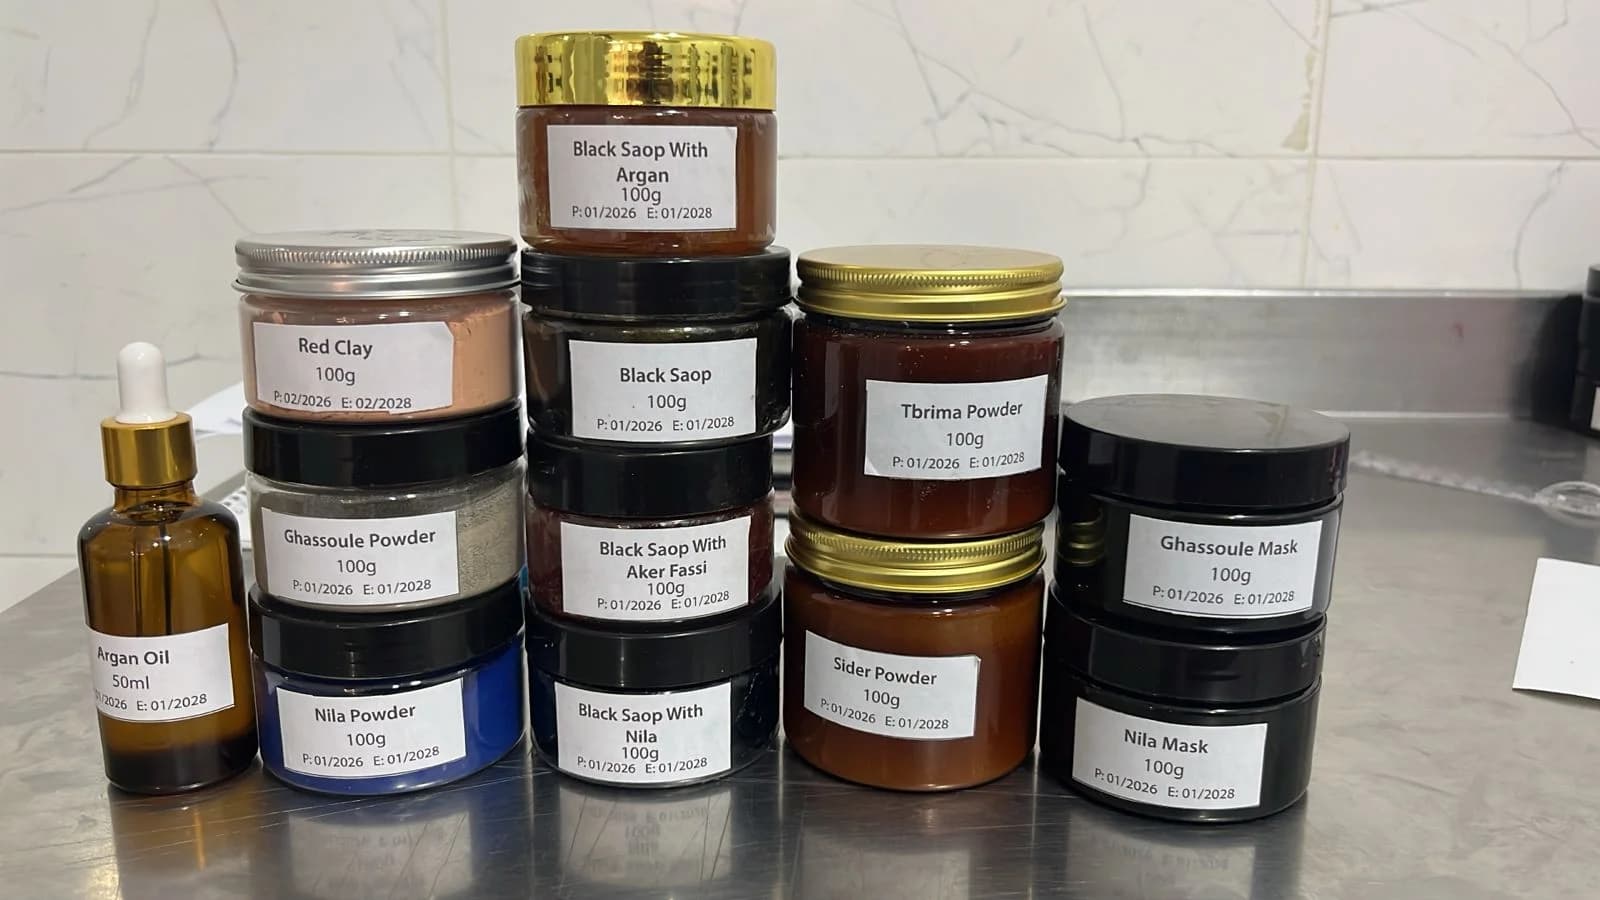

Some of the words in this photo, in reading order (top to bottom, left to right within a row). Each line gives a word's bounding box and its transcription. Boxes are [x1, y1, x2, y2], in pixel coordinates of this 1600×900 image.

[573, 139, 616, 157] Black
[620, 140, 665, 161] Saop
[668, 141, 708, 158] With
[615, 166, 669, 187] Argan
[620, 186, 661, 206] 100g
[583, 205, 636, 219] 01/2026
[660, 206, 712, 219] 01/2028
[298, 337, 330, 354] Red
[334, 339, 373, 360] Clay
[315, 366, 355, 386] 100g
[619, 367, 666, 383] Black
[669, 367, 711, 385] Saop
[283, 392, 331, 407] 02/2026
[354, 396, 411, 409] 02/2028
[647, 394, 686, 412] 100g
[900, 403, 962, 419] Tbrima
[966, 400, 1023, 419] Powder
[609, 419, 663, 432] 01/2026
[685, 416, 735, 430] 01/2028
[946, 431, 983, 449] 100g
[906, 457, 960, 469] 01/2026
[981, 451, 1024, 467] 01/2028
[283, 528, 364, 548] Ghassoule
[368, 528, 436, 547] Powder
[599, 540, 644, 557] Black
[647, 542, 689, 560] Saop
[691, 533, 726, 553] With
[1160, 535, 1254, 556] Ghassoule
[1257, 538, 1298, 556] Mask
[336, 559, 376, 576] 100g
[626, 563, 665, 579] Aker
[669, 559, 707, 578] Fassi
[1210, 566, 1251, 586] 100g
[303, 581, 353, 595] 01/2026
[376, 578, 431, 594] 01/2028
[647, 580, 684, 597] 100g
[1167, 587, 1224, 604] 01/2026
[1247, 590, 1294, 605] 01/2028
[609, 599, 661, 611] 01/2026
[683, 590, 729, 608] 01/2028
[97, 645, 139, 667] Argan
[143, 649, 169, 665] Oil
[833, 656, 873, 678] Sider
[874, 665, 937, 685] Powder
[112, 673, 149, 690] 50ml
[149, 692, 207, 711] 01/2028
[863, 688, 900, 709] 100g
[314, 707, 346, 723] Nila
[349, 704, 416, 722] Powder
[578, 702, 618, 721] Black
[621, 707, 663, 725] Saop
[665, 703, 703, 720] With
[830, 702, 876, 724] 01/2026
[897, 717, 949, 729] 01/2028
[346, 732, 385, 748] 100g
[625, 728, 657, 743] Nila
[1124, 728, 1157, 748] Nila
[1161, 736, 1208, 753] Mask
[313, 754, 363, 767] 01/2026
[386, 745, 440, 764] 01/2028
[621, 745, 658, 762] 100g
[587, 759, 636, 774] 01/2026
[657, 756, 707, 773] 01/2028
[1144, 758, 1184, 780] 100g
[1106, 772, 1158, 795] 01/2026
[1181, 787, 1235, 799] 01/2028
